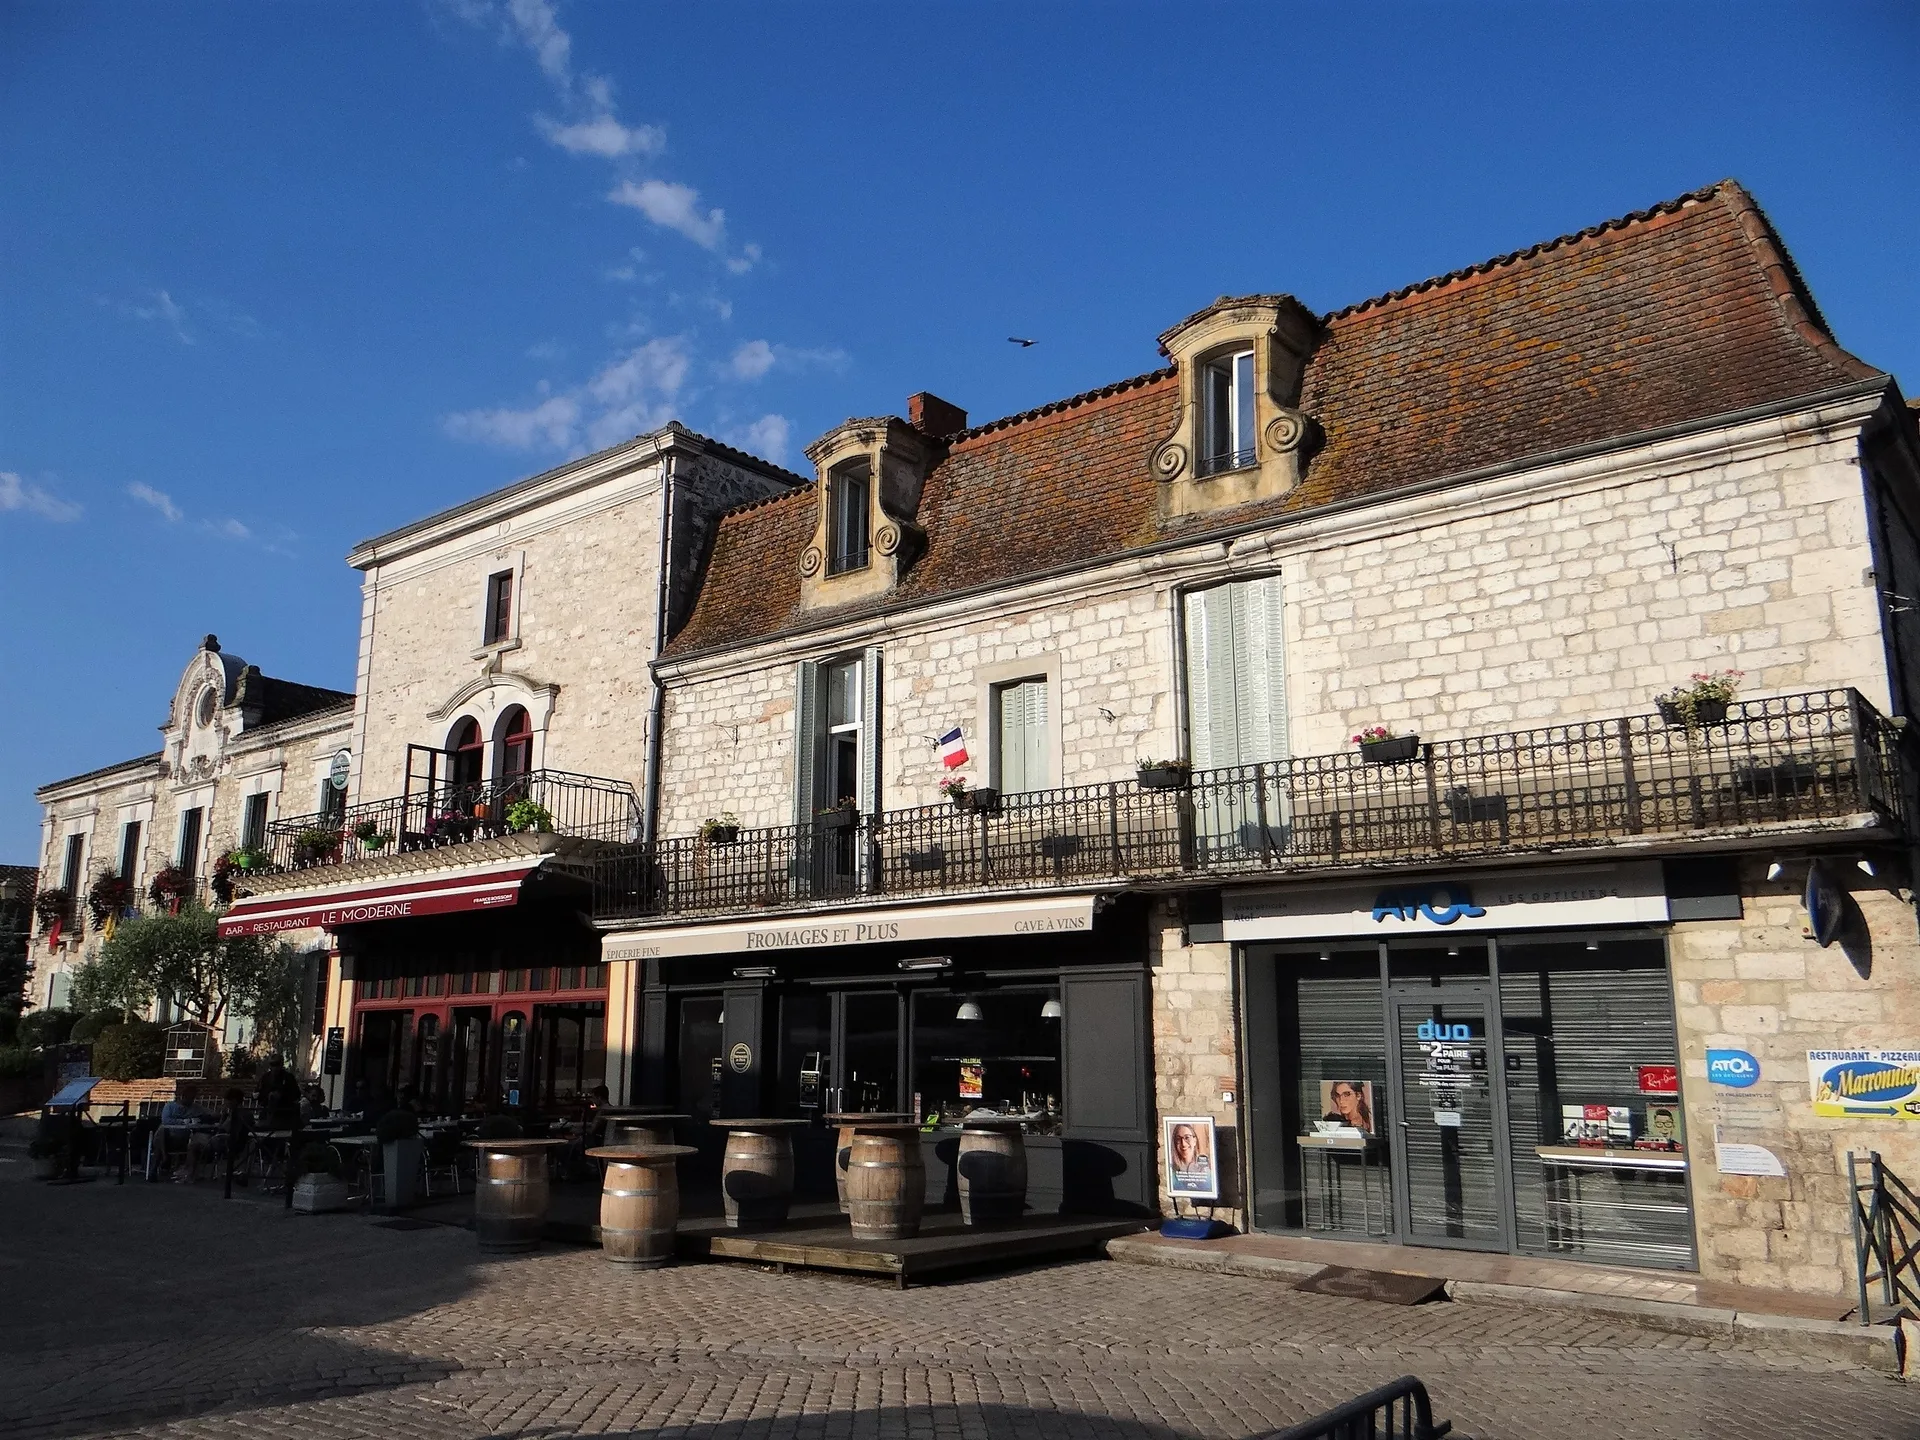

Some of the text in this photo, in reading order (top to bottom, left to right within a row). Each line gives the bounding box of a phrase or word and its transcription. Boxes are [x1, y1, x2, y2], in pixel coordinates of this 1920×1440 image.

[1499, 888, 1618, 903] LES OPTICIENS
[321, 902, 412, 924] LE MODERNE
[225, 925, 244, 936] BAR
[252, 917, 311, 932] RESTAURANT
[1014, 916, 1085, 932] CAVE À VINS
[746, 922, 899, 949] FROMAGES ET PLUS
[606, 946, 660, 959] ÉPICERIE FINE
[1417, 1019, 1470, 1040] duo
[1430, 1041, 1443, 1057] 2
[1443, 1050, 1469, 1058] PAIRE
[1809, 1051, 1870, 1060] RESTAURANT
[1711, 1057, 1754, 1073] ATOL
[1643, 1069, 1677, 1088] Ray-Ban
